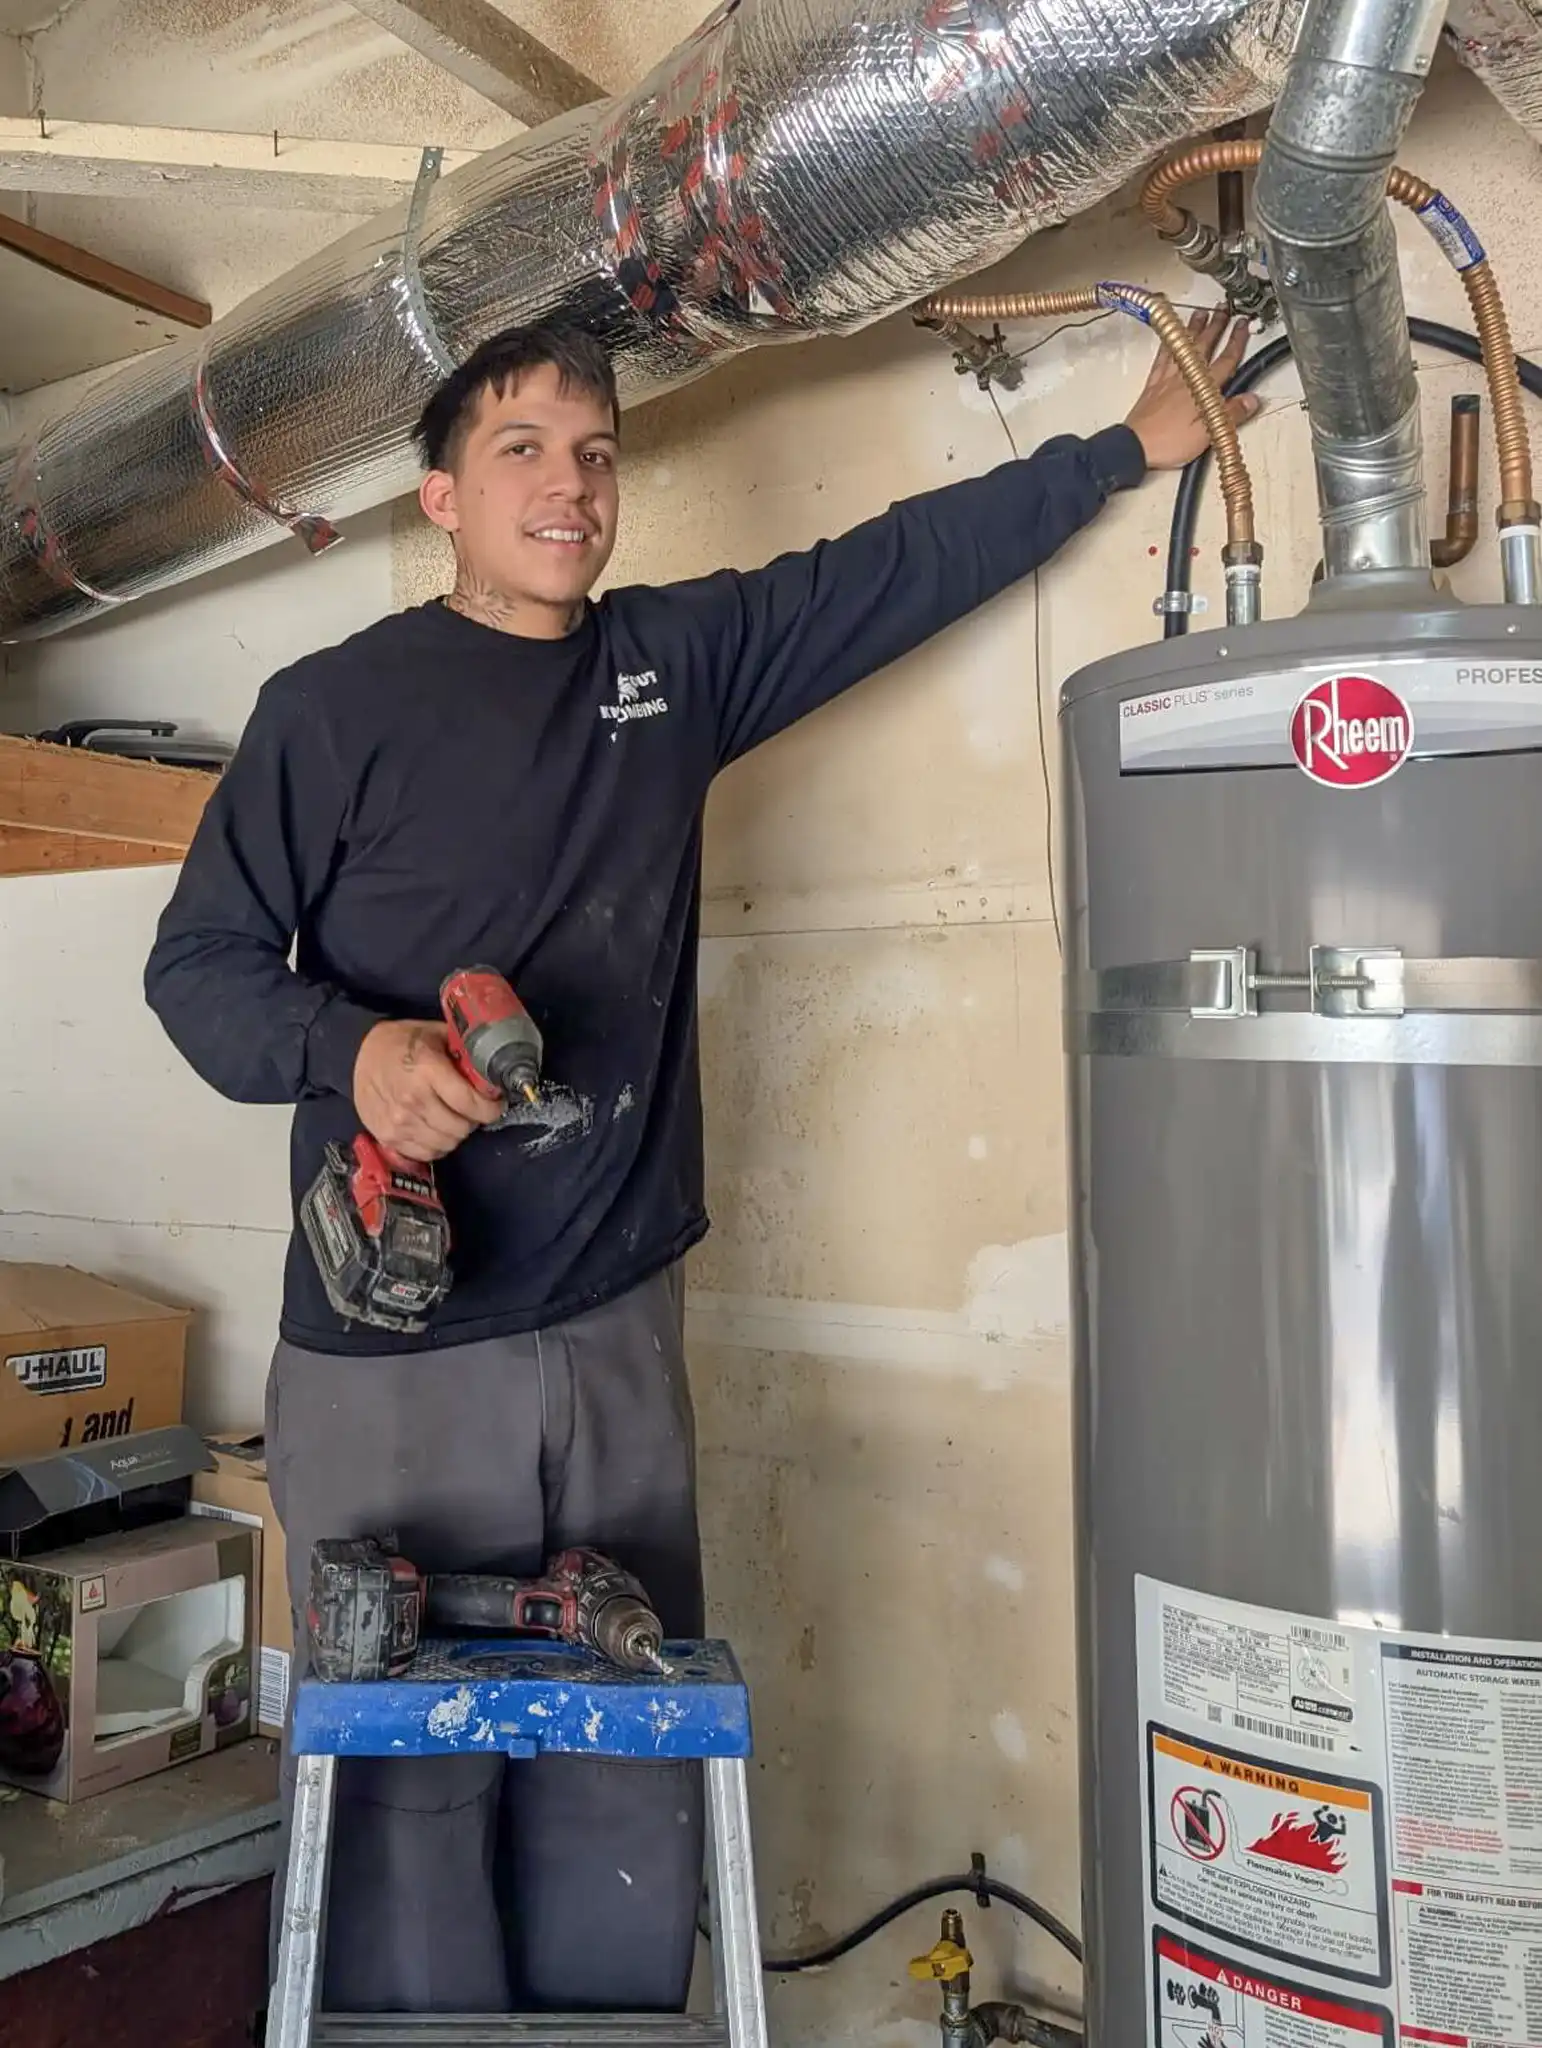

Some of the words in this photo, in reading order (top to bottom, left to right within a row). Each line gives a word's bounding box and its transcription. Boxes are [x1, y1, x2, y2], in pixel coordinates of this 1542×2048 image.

[1123, 697, 1172, 718] CLASSIC
[1212, 687, 1255, 701] series
[1303, 678, 1406, 770] Rheem
[1411, 1649, 1472, 1665] INSTALLATION
[1473, 1656, 1493, 1666] AND
[1416, 1668, 1468, 1682] AUTOMATIC
[1469, 1674, 1509, 1685] STORAGE
[1511, 1677, 1541, 1687] WATER
[1220, 1760, 1299, 1793] WARNING
[1246, 1858, 1292, 1878] Flammable
[1294, 1874, 1325, 1888] Vapors
[1466, 1894, 1494, 1905] SAFETY
[1233, 1975, 1302, 2010] DANGER
